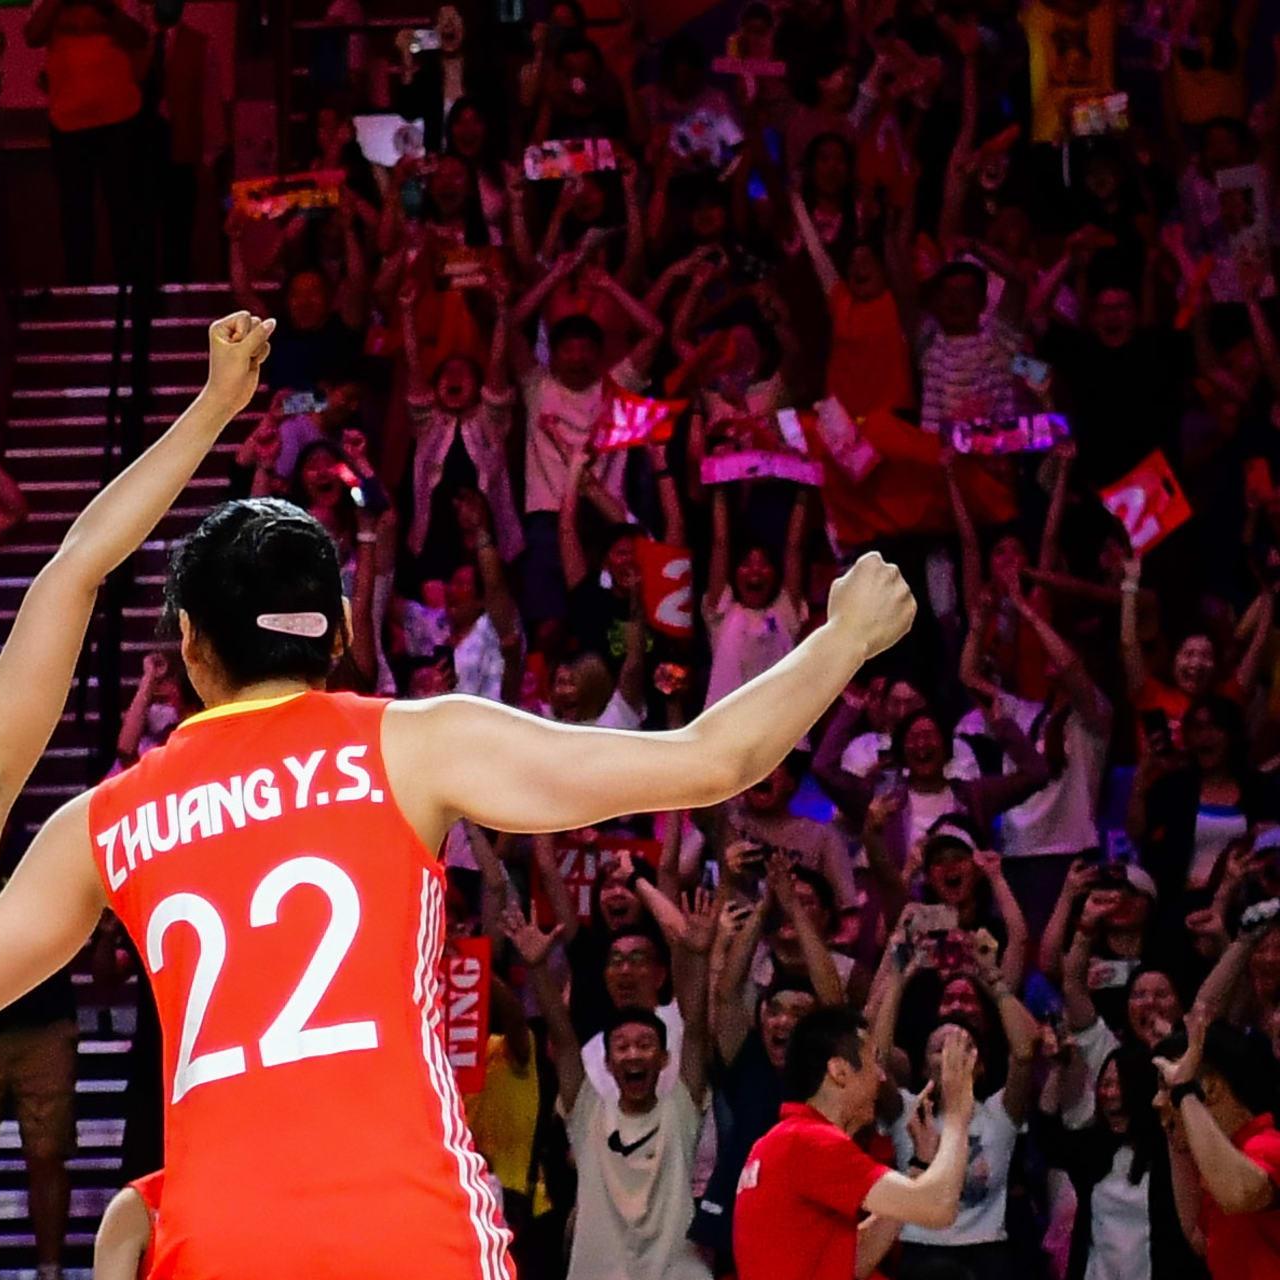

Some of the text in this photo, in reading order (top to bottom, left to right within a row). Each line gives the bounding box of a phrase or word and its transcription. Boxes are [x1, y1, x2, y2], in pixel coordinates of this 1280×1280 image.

[96, 744, 385, 893] ZHUANG Y.S.
[145, 855, 380, 1106] 22
[448, 957, 481, 1067] TING
